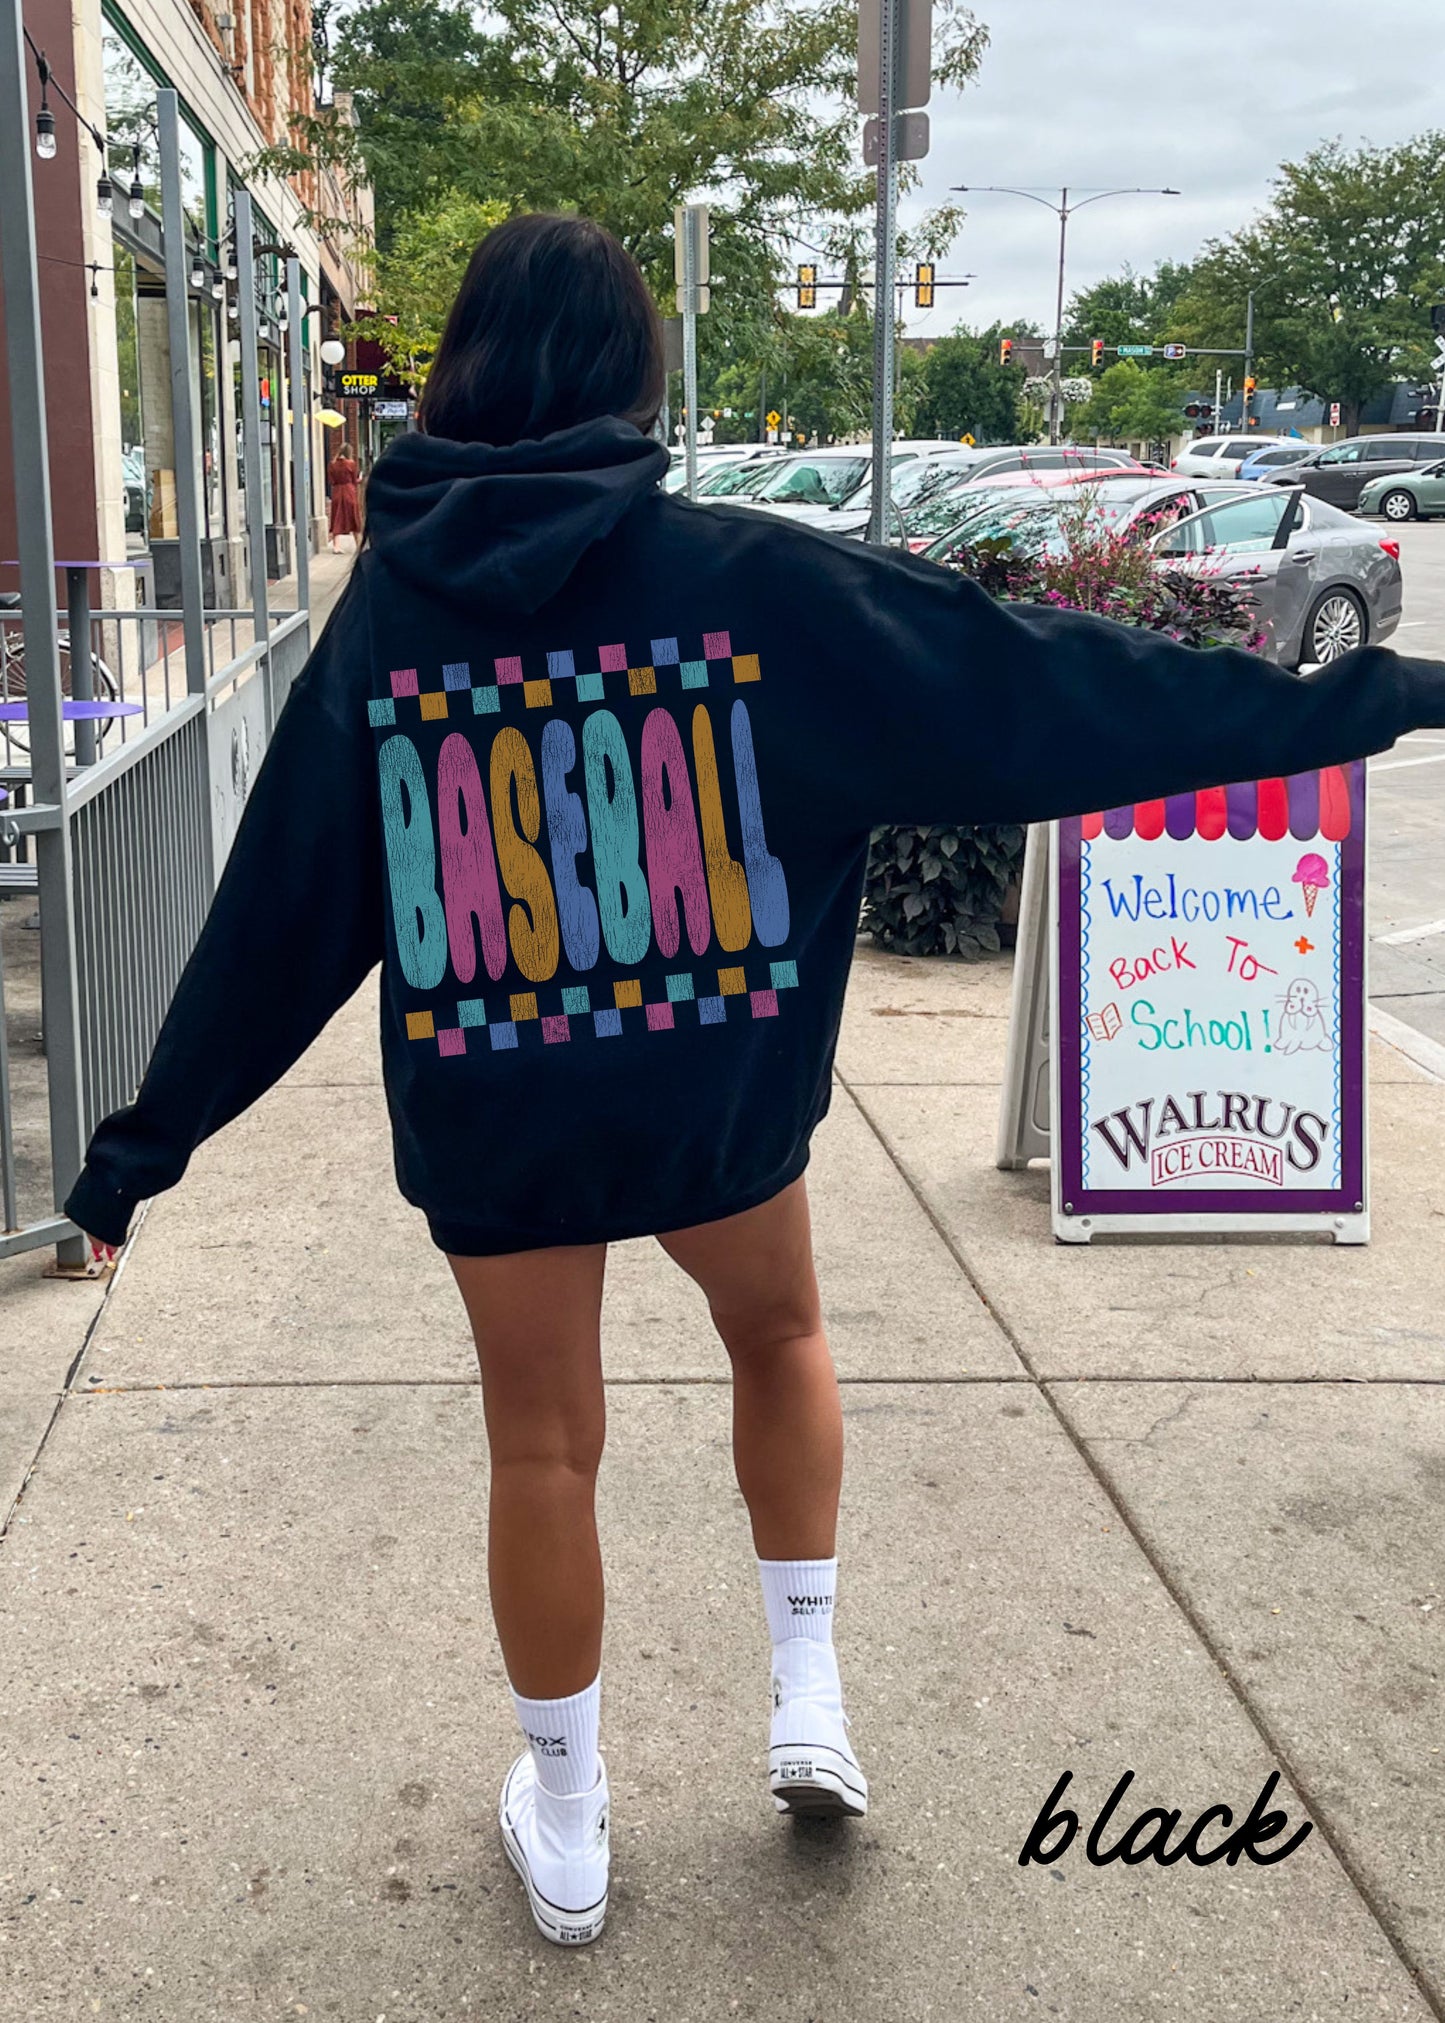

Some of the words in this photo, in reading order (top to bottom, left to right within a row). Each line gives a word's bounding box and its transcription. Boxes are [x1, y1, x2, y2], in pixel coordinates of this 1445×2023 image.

[341, 374, 378, 386] OTTER
[343, 385, 376, 395] SHOP
[378, 699, 790, 989] BASEBALL
[1102, 873, 1295, 922] Welcome
[1225, 936, 1279, 981] To
[1090, 1090, 1329, 1172] WALRUS
[1156, 1146, 1193, 1173] ICE
[1199, 1141, 1279, 1178] CREAM
[541, 1748, 568, 1757] CLUB
